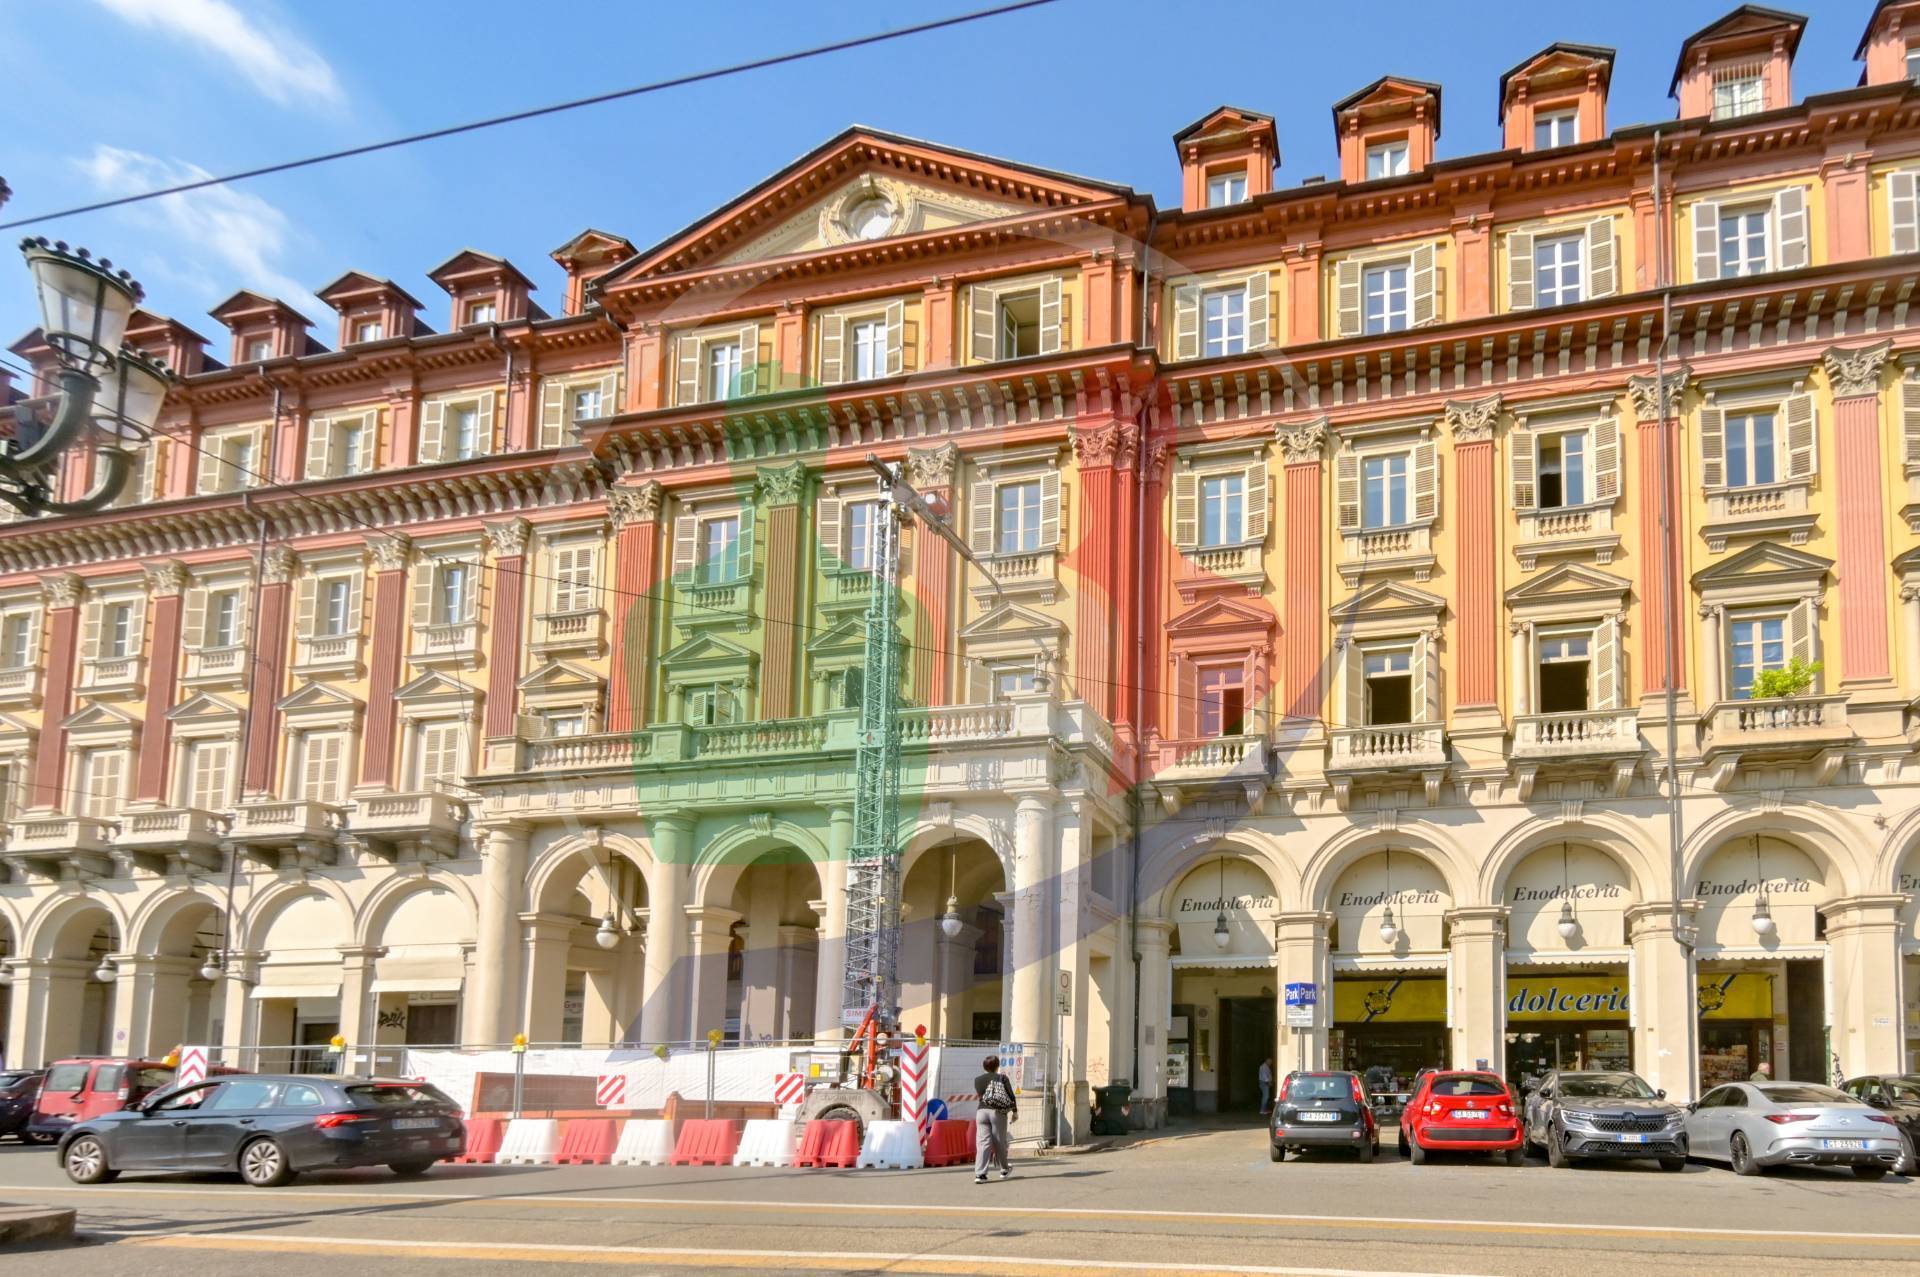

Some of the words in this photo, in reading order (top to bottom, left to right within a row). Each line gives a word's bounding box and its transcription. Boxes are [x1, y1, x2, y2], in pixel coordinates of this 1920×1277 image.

[1513, 883, 1620, 901] Enodolceria
[1697, 878, 1810, 896] Enodolceria
[1180, 895, 1274, 912] Enodolceria
[1340, 889, 1440, 906] Enodolceria
[1286, 988, 1298, 1001] Park
[1300, 987, 1316, 1000] Park
